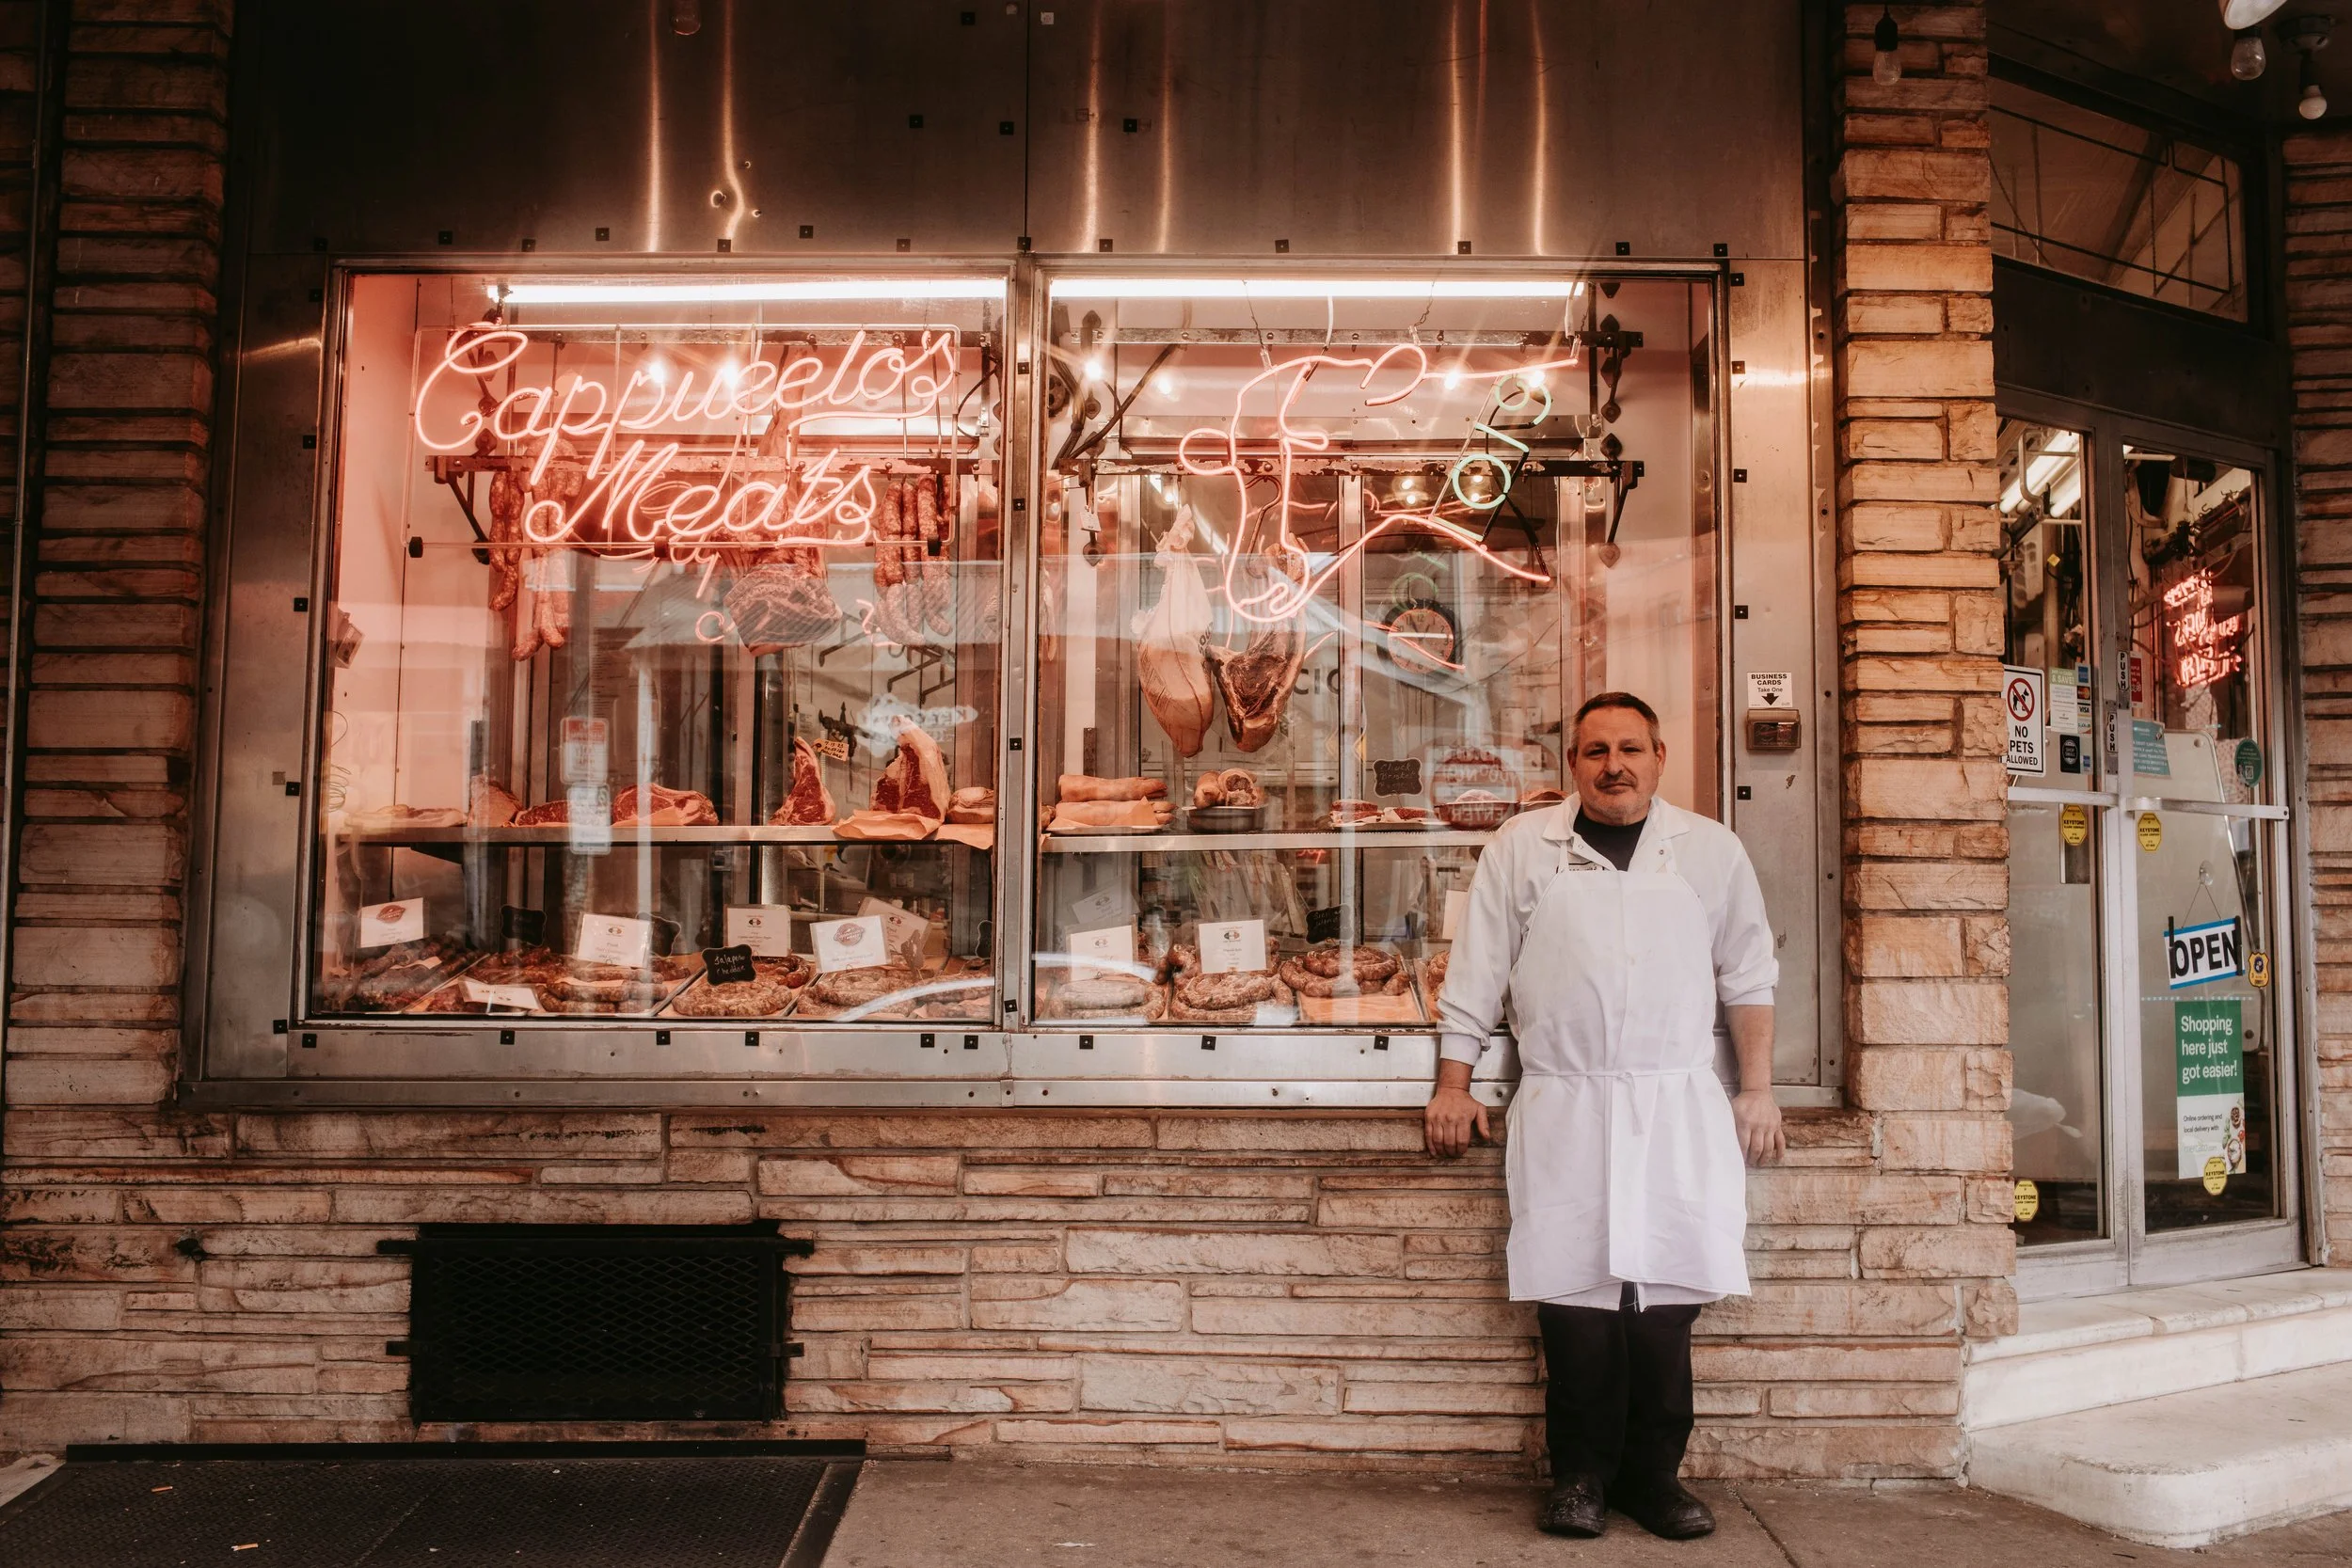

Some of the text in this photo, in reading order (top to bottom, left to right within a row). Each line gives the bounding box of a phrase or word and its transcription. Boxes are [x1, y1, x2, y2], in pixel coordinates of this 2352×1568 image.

[524, 438, 877, 544] Meats
[2014, 724, 2028, 738] NO
[2010, 739, 2034, 753] PETS
[2006, 755, 2039, 766] ALLOWED
[2170, 930, 2242, 977] OPEN
[2181, 1015, 2233, 1036] Shopping
[2182, 1038, 2228, 1058] here just
[2182, 1059, 2237, 1085] got easier!
[2197, 1114, 2215, 1122] ordering
